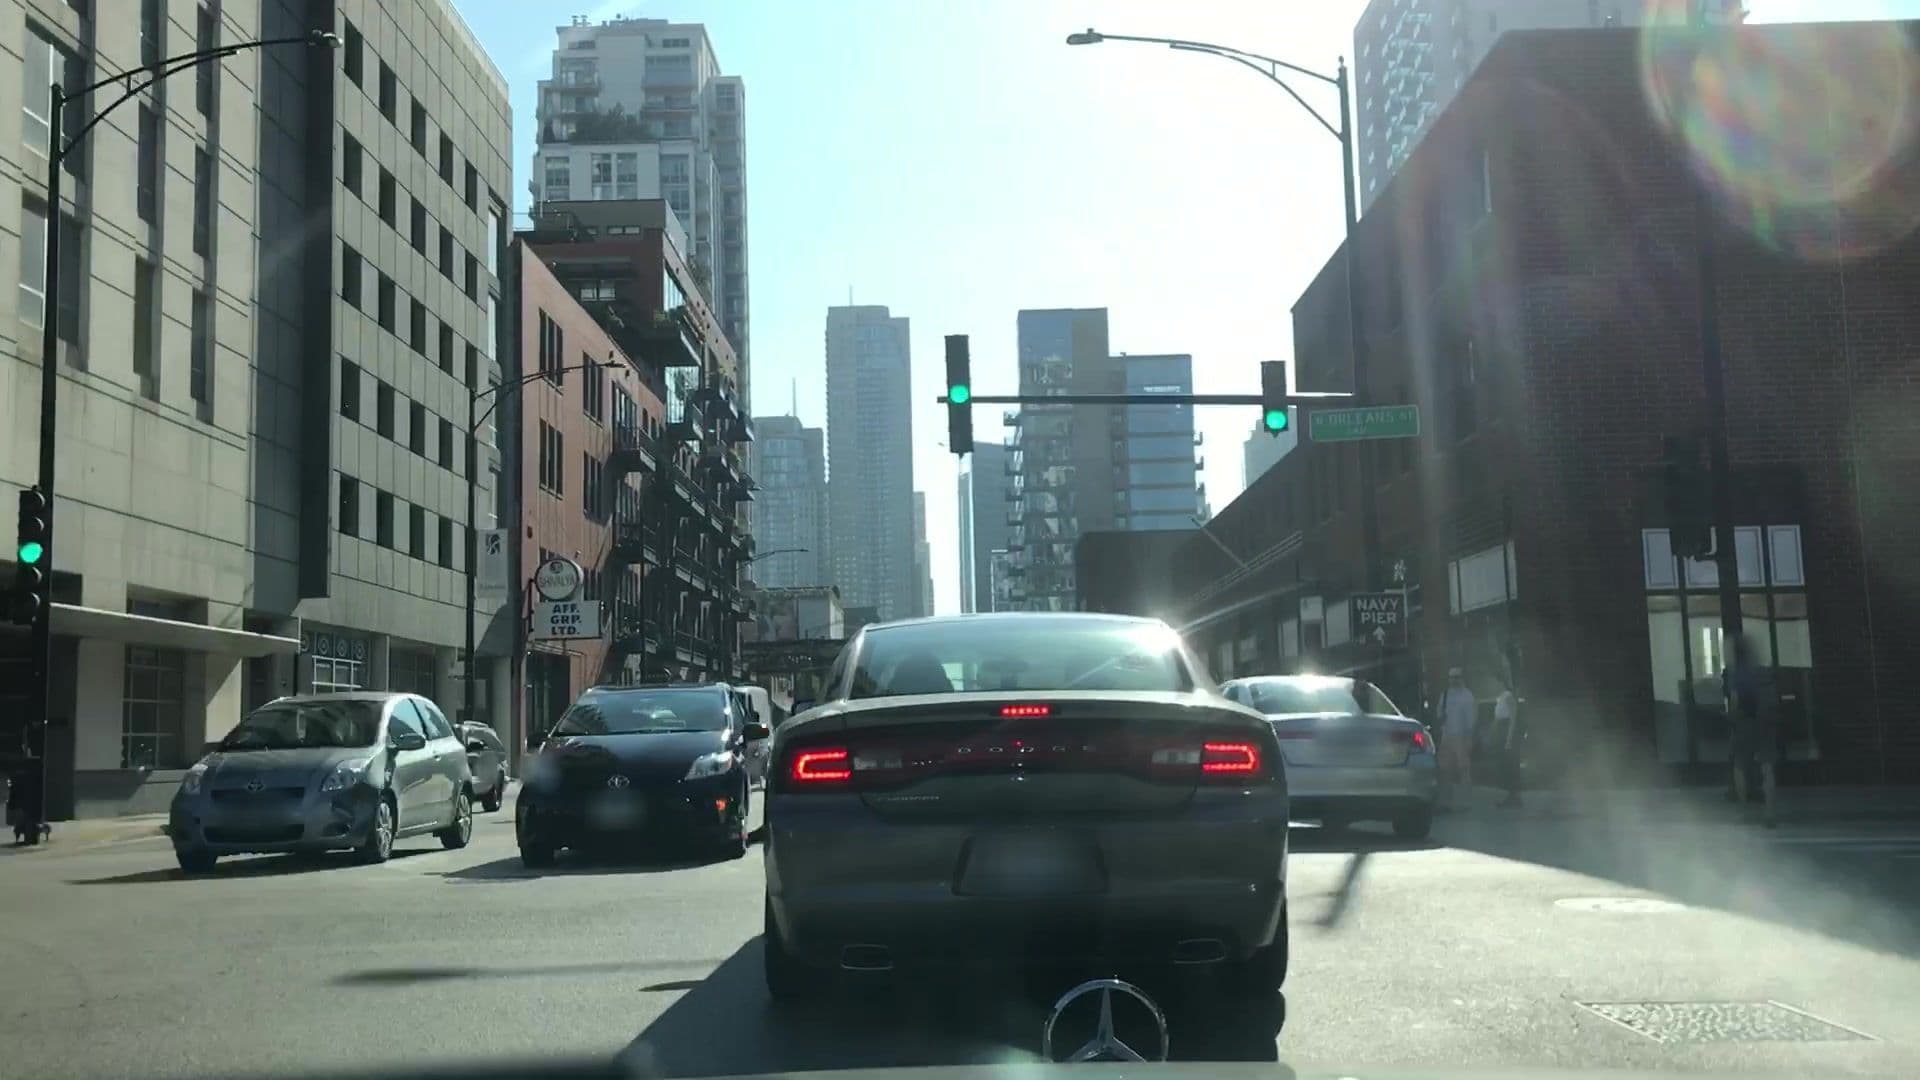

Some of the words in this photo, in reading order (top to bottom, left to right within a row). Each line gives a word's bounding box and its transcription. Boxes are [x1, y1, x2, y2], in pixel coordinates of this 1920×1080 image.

[1328, 411, 1394, 425] ORLEANS
[552, 603, 579, 614] AFF.
[1356, 597, 1400, 611] NAVY
[550, 614, 582, 625] GRP.
[1360, 611, 1397, 625] PIER
[551, 625, 580, 636] LTD.
